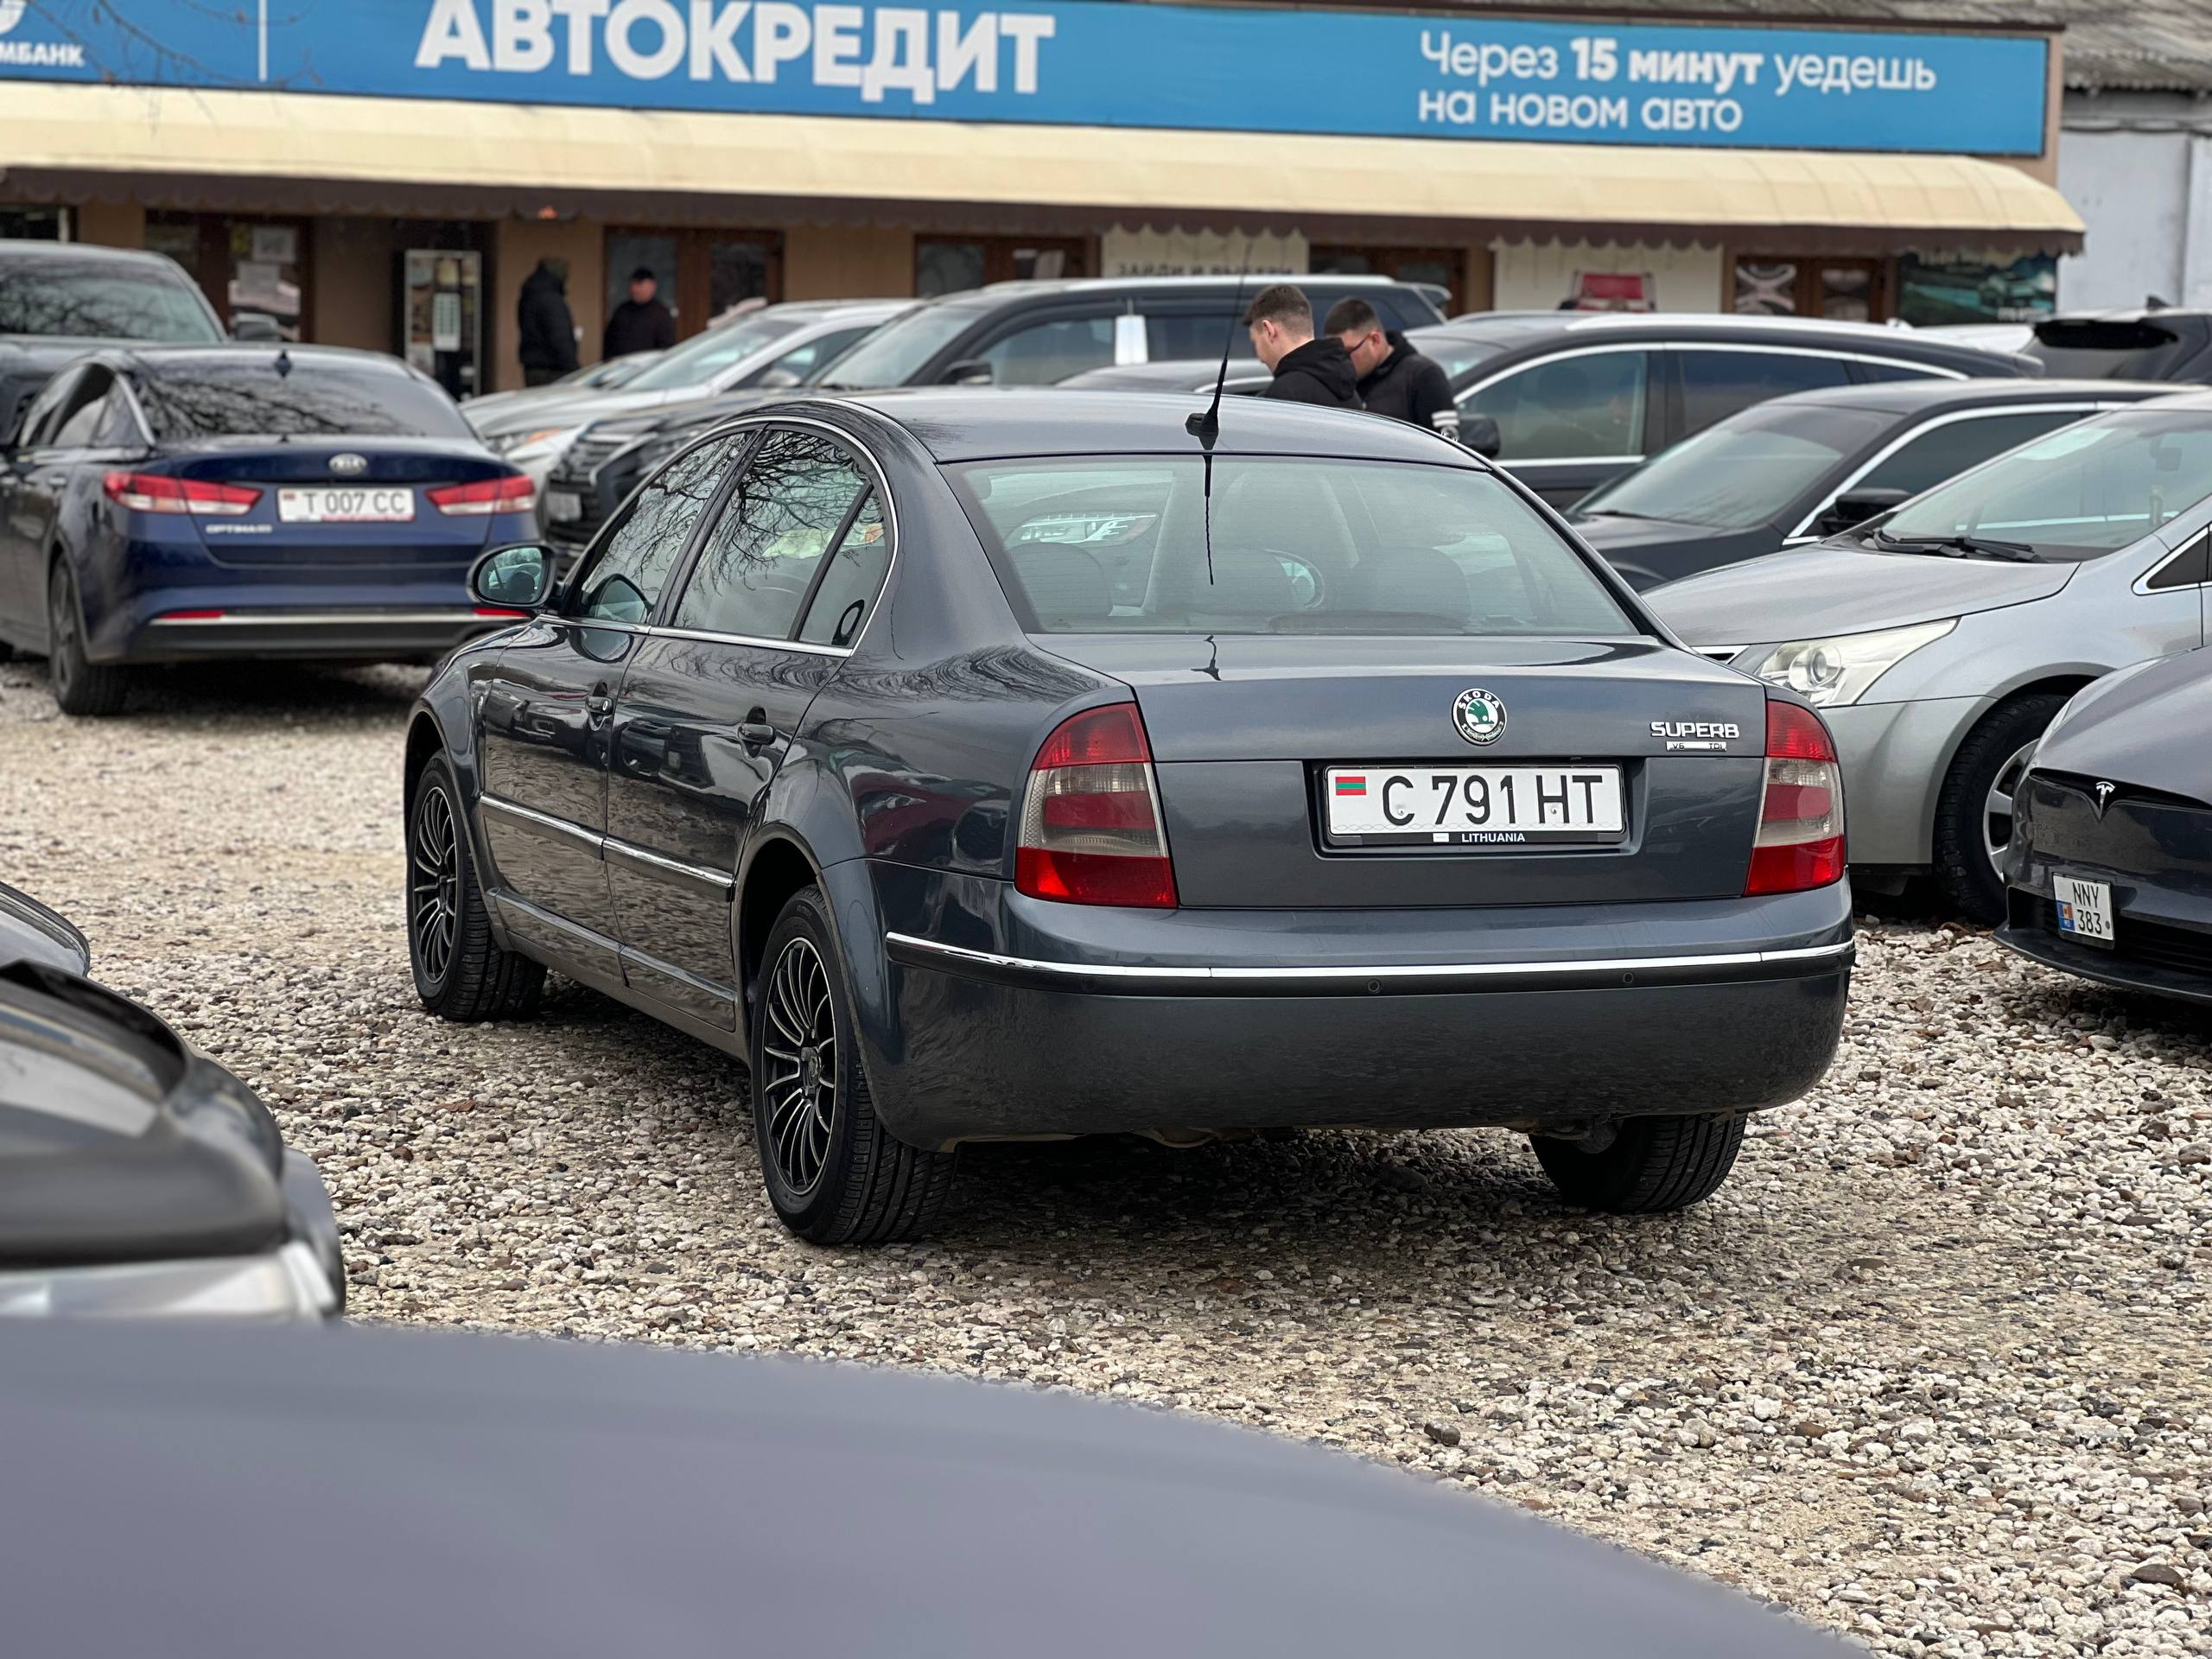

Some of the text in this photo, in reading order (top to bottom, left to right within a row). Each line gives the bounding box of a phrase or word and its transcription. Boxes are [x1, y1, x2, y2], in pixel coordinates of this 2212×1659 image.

[414, 0, 1056, 104] АВТОКРЕДИТ
[1421, 31, 1936, 95] Через 15 минут уедешь
[1418, 90, 1742, 131] на новом авто
[325, 492, 365, 513] 007
[372, 492, 404, 513] CC
[1650, 721, 1739, 739] SUPERB
[1382, 774, 1603, 825] C 791 HT
[1461, 832, 1526, 843] LITHUANIA
[2073, 881, 2099, 908] NNY
[2076, 909, 2102, 934] 383
